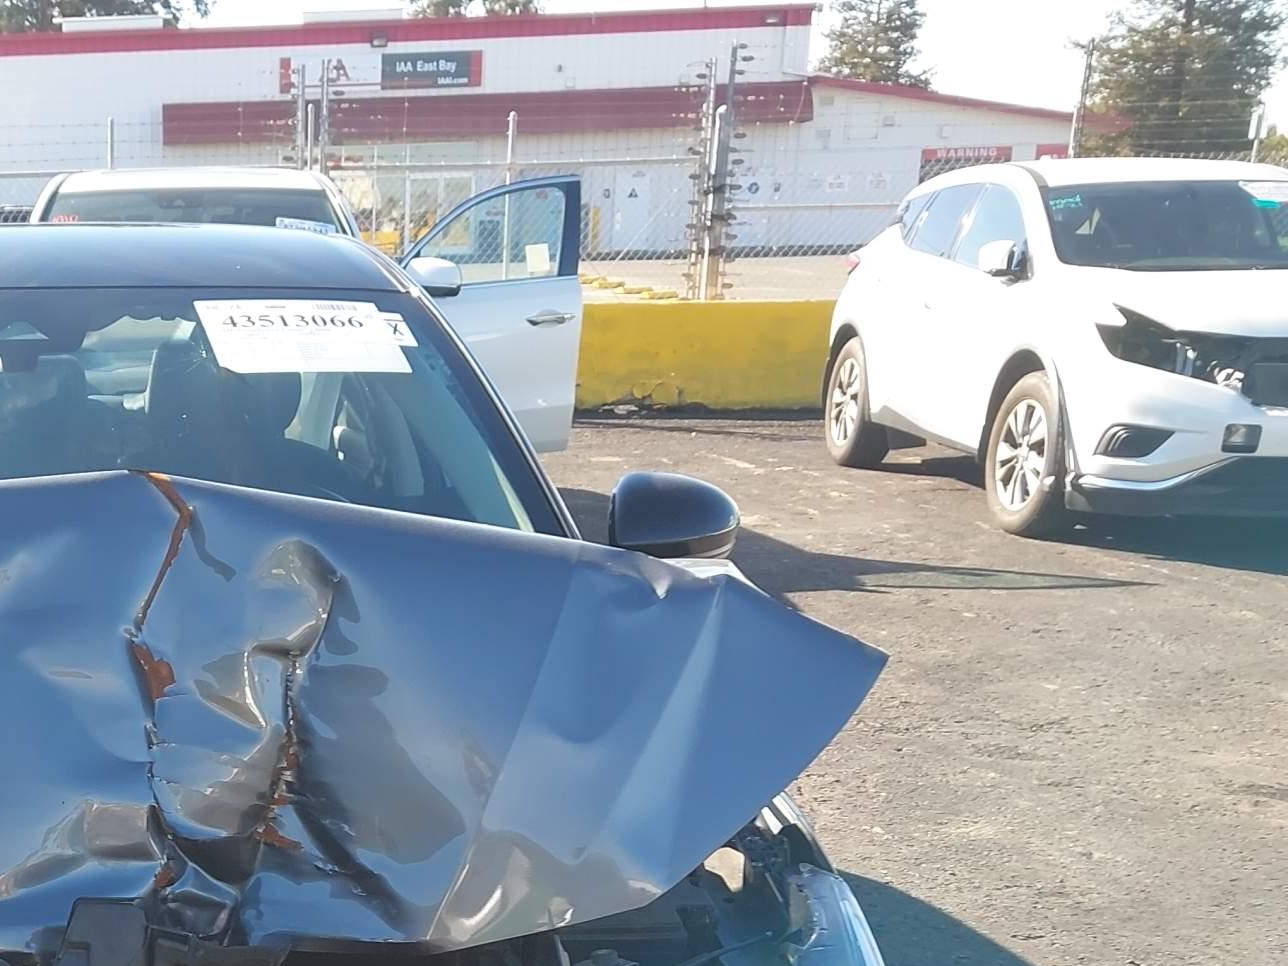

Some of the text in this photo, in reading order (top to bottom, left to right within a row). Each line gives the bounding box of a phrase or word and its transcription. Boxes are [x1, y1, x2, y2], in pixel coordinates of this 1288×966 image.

[396, 59, 457, 73] IAA East Bay
[936, 147, 997, 159] WARNING
[222, 314, 364, 329] 43513066
